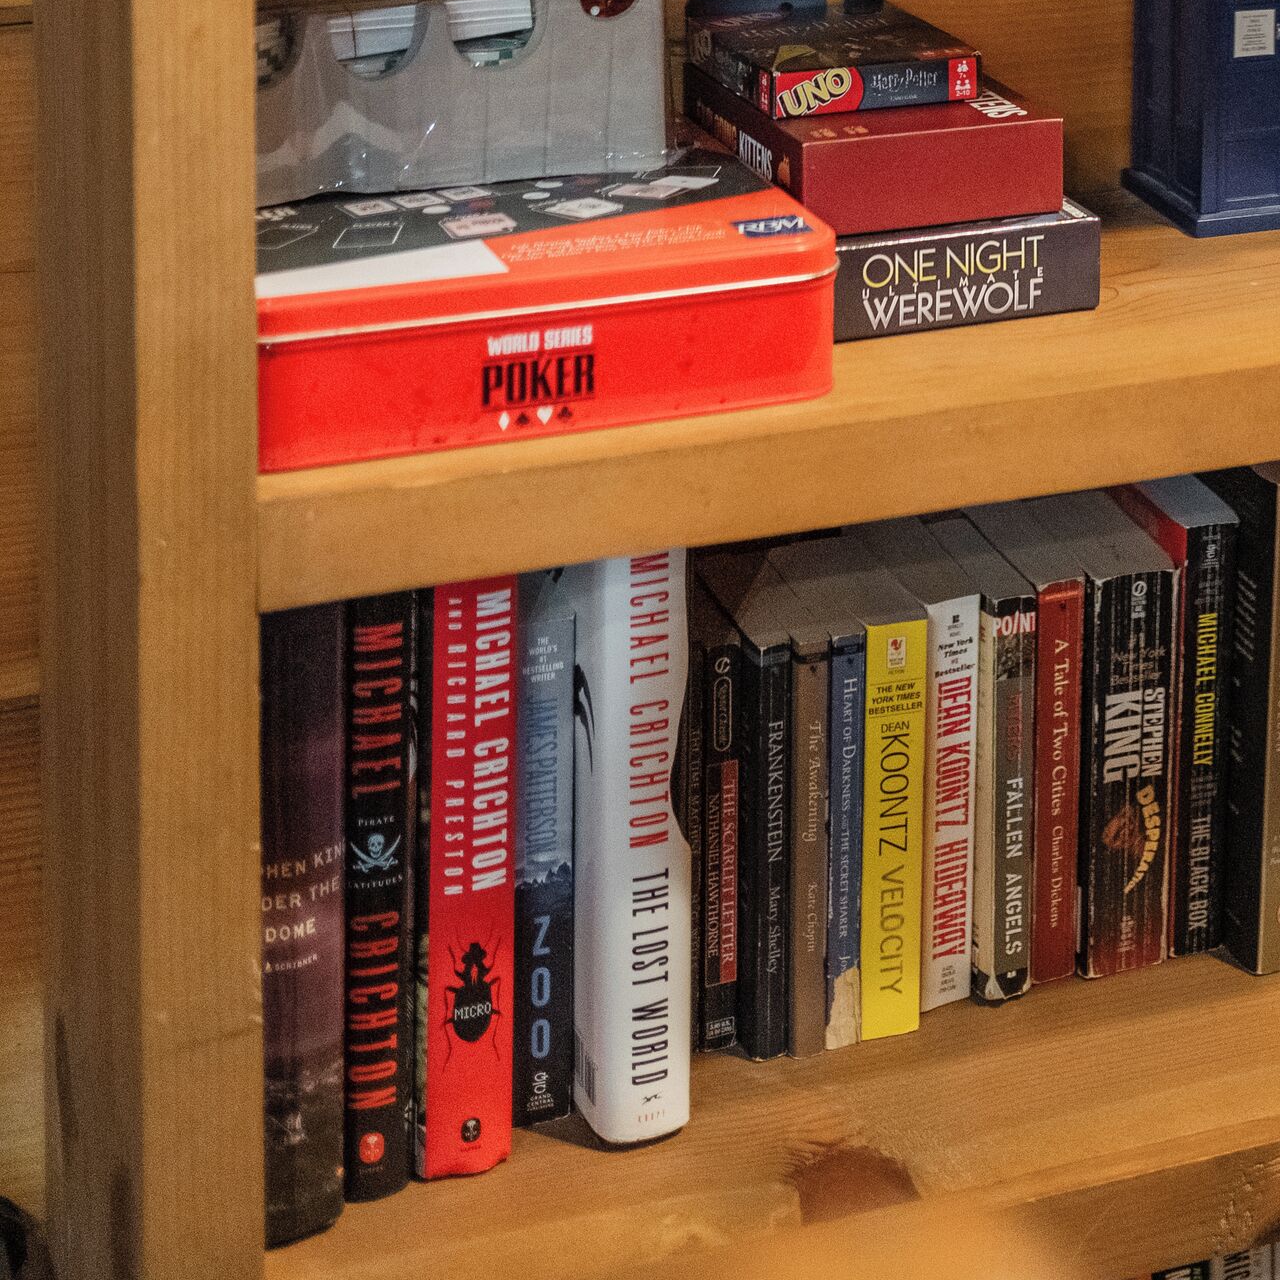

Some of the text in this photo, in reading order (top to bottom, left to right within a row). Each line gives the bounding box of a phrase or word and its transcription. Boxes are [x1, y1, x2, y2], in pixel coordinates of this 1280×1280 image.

[778, 67, 853, 117] UNO
[955, 89, 972, 98] 2-10
[738, 130, 773, 183] KITTENS
[862, 234, 1045, 289] ONE NIGHT
[862, 277, 1044, 331] WEREWOLF
[481, 353, 595, 408] POKER
[486, 324, 594, 357] WORLD SERIES
[351, 621, 404, 799] MICHAEL
[628, 551, 670, 851] MICHAEL CRICHTON
[868, 702, 923, 717] BESTSELLER
[871, 692, 921, 706] YORK TIMES
[876, 682, 916, 695] THE NEW
[880, 721, 910, 734] DEAN
[936, 676, 972, 739] DEAN
[1140, 687, 1165, 777] STEPHEN
[443, 596, 468, 898] AND RICHARD PRESTON
[470, 588, 513, 894] MICHAEL CRICHTON
[522, 696, 559, 858] JAMES PATTERSON
[1102, 689, 1142, 785] KING
[1187, 612, 1218, 931] MICHAEL CONNELLY THE BLACK BOX
[934, 741, 970, 833] KOONTZ
[1004, 776, 1025, 859] FALLEN
[1048, 639, 1071, 929] A Tale of Two Cities Charles Dickens
[706, 794, 720, 965] NATHANIEL HAWTHORNE
[720, 780, 736, 965] THE SCARLET LETTER
[764, 719, 785, 975] FRANKENSTEIN Mary Shelley
[801, 721, 823, 953] The Awakening Kate Chopin
[878, 733, 911, 995] KOONTZ VELOCITY
[264, 917, 317, 944] DOME
[931, 837, 967, 962] HIDEAWAY
[1004, 872, 1024, 956] ANGELS
[348, 909, 400, 1111] CRICHTON
[454, 1001, 493, 1023] MICRO
[630, 868, 670, 1088] THE LOST WORLD
